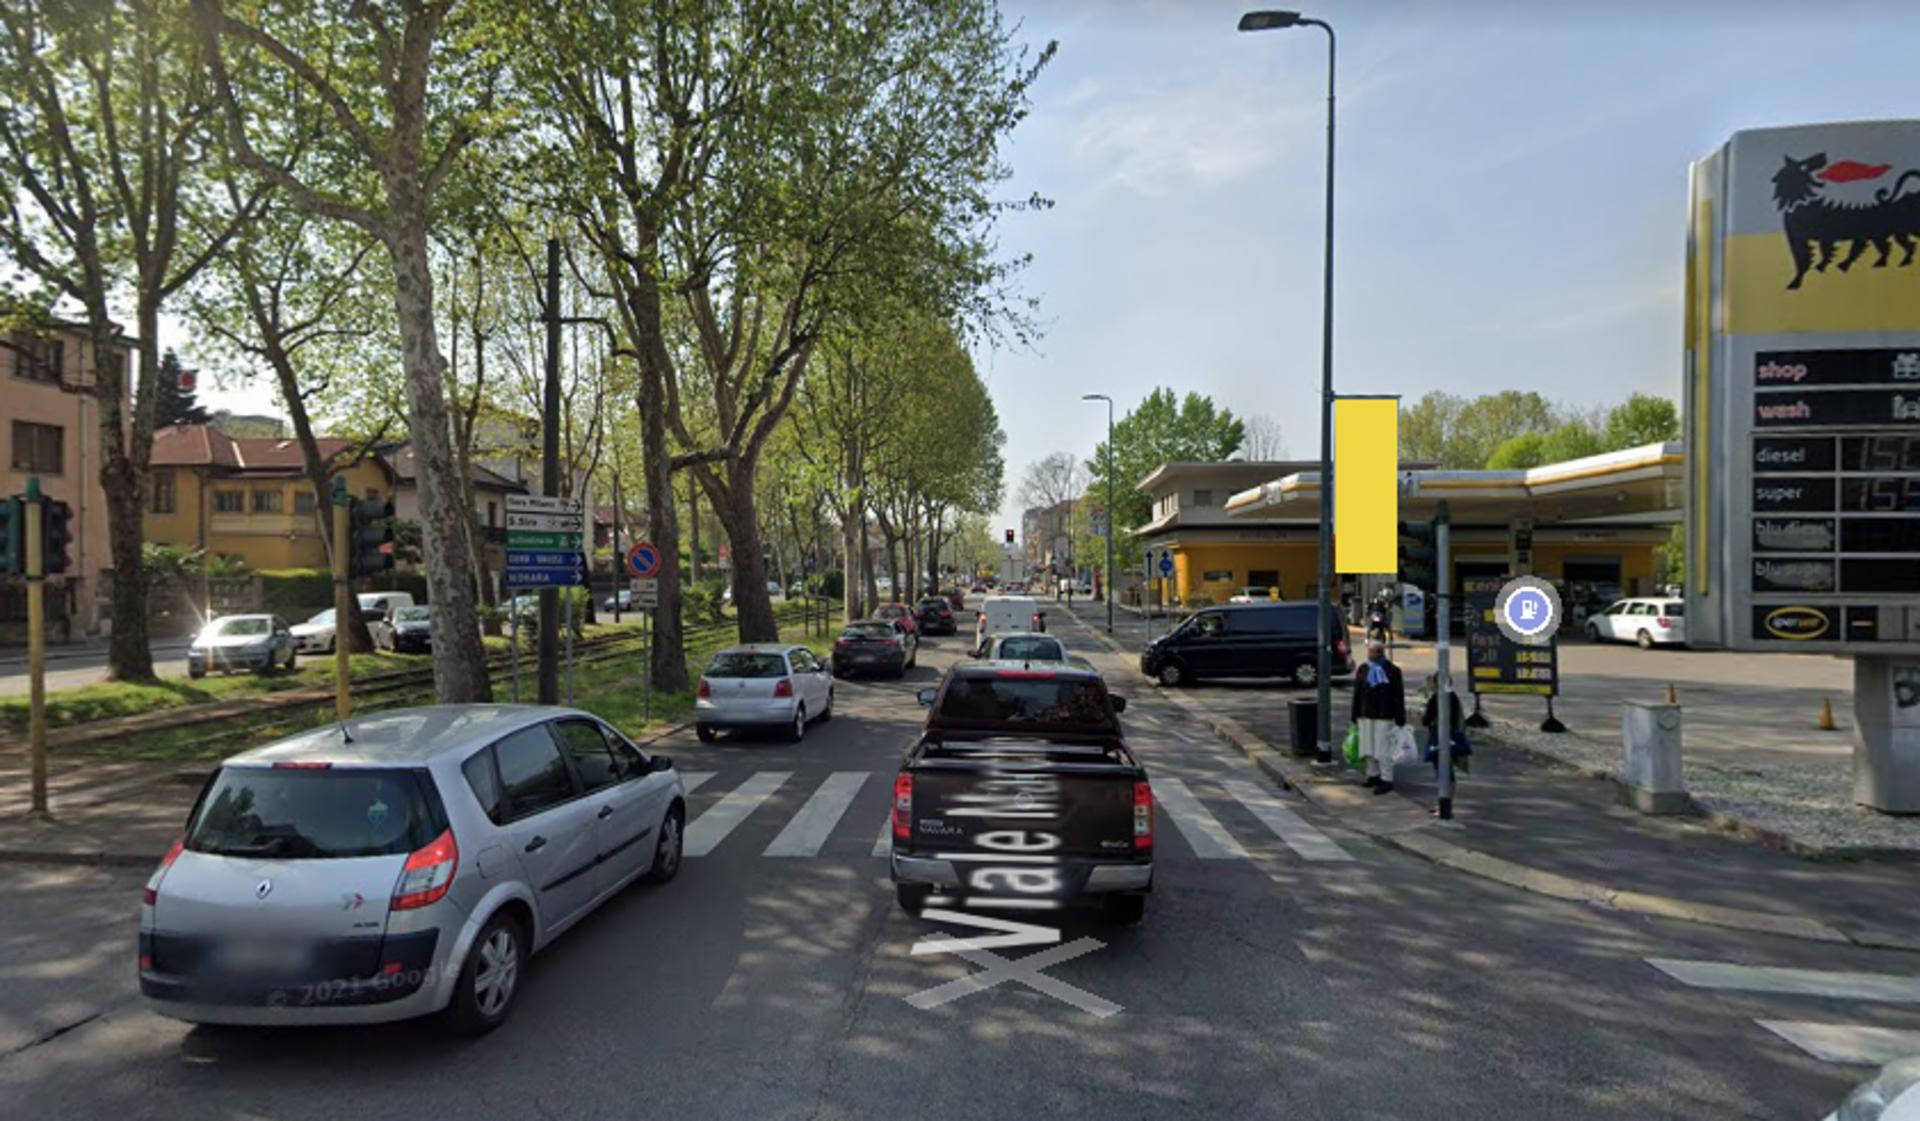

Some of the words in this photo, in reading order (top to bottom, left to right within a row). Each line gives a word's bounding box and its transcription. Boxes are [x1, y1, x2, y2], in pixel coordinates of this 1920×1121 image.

[1758, 360, 1807, 382] shop
[1757, 400, 1811, 418] wash
[1756, 447, 1805, 463] diesel
[1756, 483, 1803, 501] super
